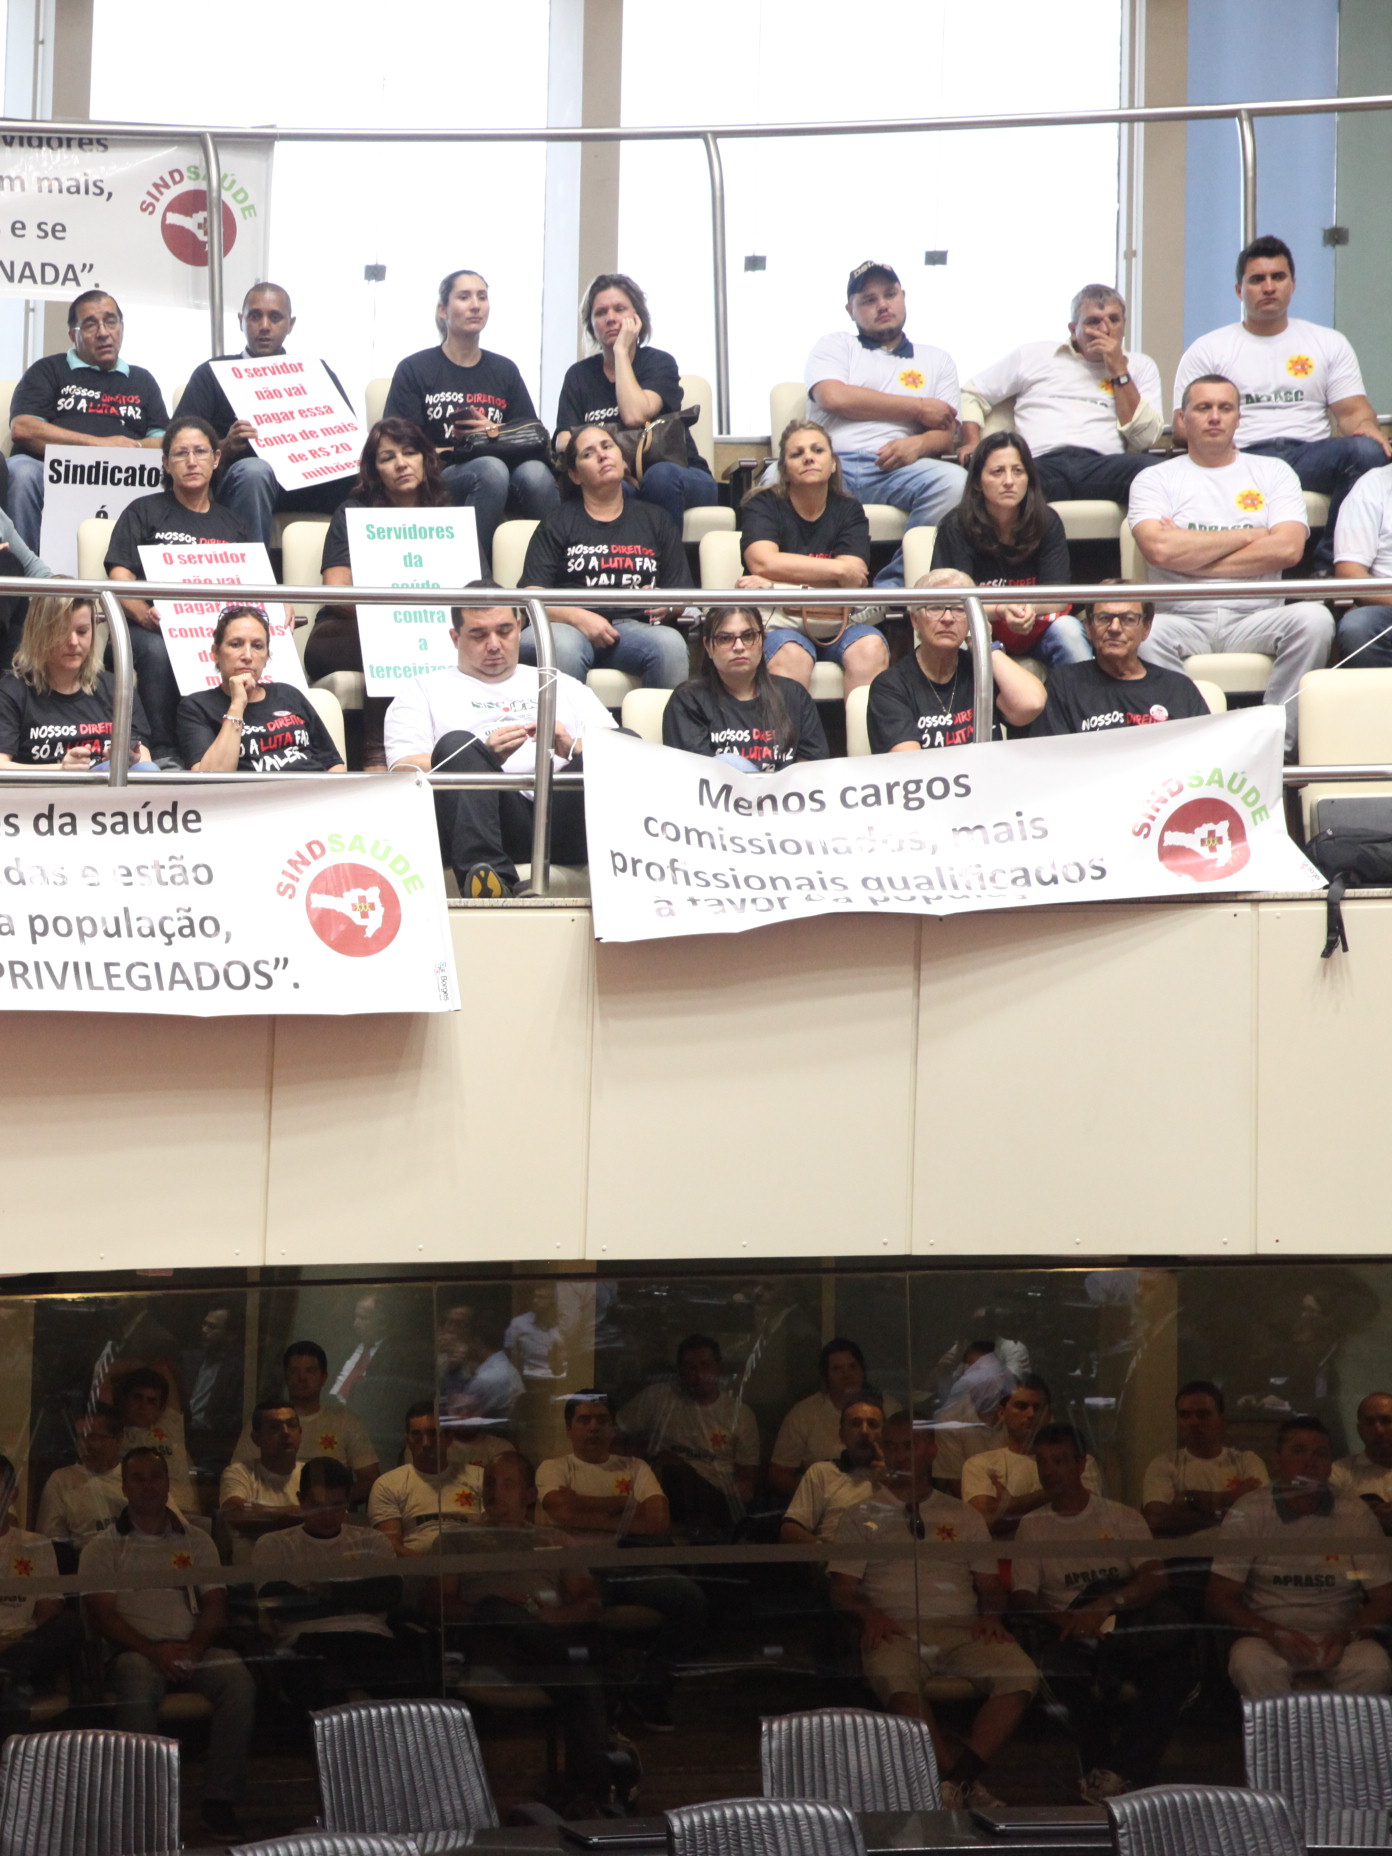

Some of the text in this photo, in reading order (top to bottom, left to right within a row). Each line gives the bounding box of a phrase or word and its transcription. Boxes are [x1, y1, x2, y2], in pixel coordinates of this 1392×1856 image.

[36, 172, 113, 203] mais,
[140, 165, 257, 220] SINDSÚDE
[10, 219, 27, 239] e
[36, 220, 67, 241] se
[231, 362, 304, 379] O servidor
[61, 385, 101, 399] NOSSOS
[254, 384, 308, 401] não vai
[425, 391, 508, 409] NOSSOS DIREITOS
[57, 395, 142, 420] SÓ A LUTA FAZ
[253, 404, 334, 426] pagar essa
[427, 402, 442, 420] SÓ
[255, 422, 358, 448] conta de mais
[288, 453, 308, 463] de
[331, 442, 353, 455] 20
[49, 458, 161, 488] Sindicato
[301, 459, 362, 480] milhões
[155, 532, 197, 545] NOSSOS
[365, 524, 455, 540] Servidores
[162, 551, 246, 565] O servidor
[403, 552, 423, 568] da
[567, 544, 609, 556] NOSSOS
[567, 554, 657, 573] SÓ A LUTA FAZ
[173, 602, 222, 615] pagar
[393, 609, 446, 624] contra
[418, 638, 428, 651] a
[918, 713, 953, 728] OSSOS
[1082, 711, 1124, 730] NOSSOS
[30, 725, 77, 740] NOSSOS
[934, 731, 944, 747] A
[31, 739, 50, 760] SÓ
[54, 742, 64, 757] A
[250, 738, 260, 755] A
[260, 732, 293, 752] LUTA
[741, 746, 773, 761] LUTA
[251, 746, 308, 772] VALER
[698, 773, 972, 816] Menos cargos
[1131, 767, 1270, 839] SINDSAÚDE
[33, 803, 78, 836] da
[91, 801, 202, 836] saúde
[951, 811, 1048, 846] mais
[81, 865, 100, 886] e
[113, 855, 214, 887] estão
[276, 833, 425, 899] SINDSAÚDE
[610, 849, 1107, 894] profissionais qualificados
[28, 906, 232, 946] população,
[1273, 1574, 1336, 1588] APRASC
